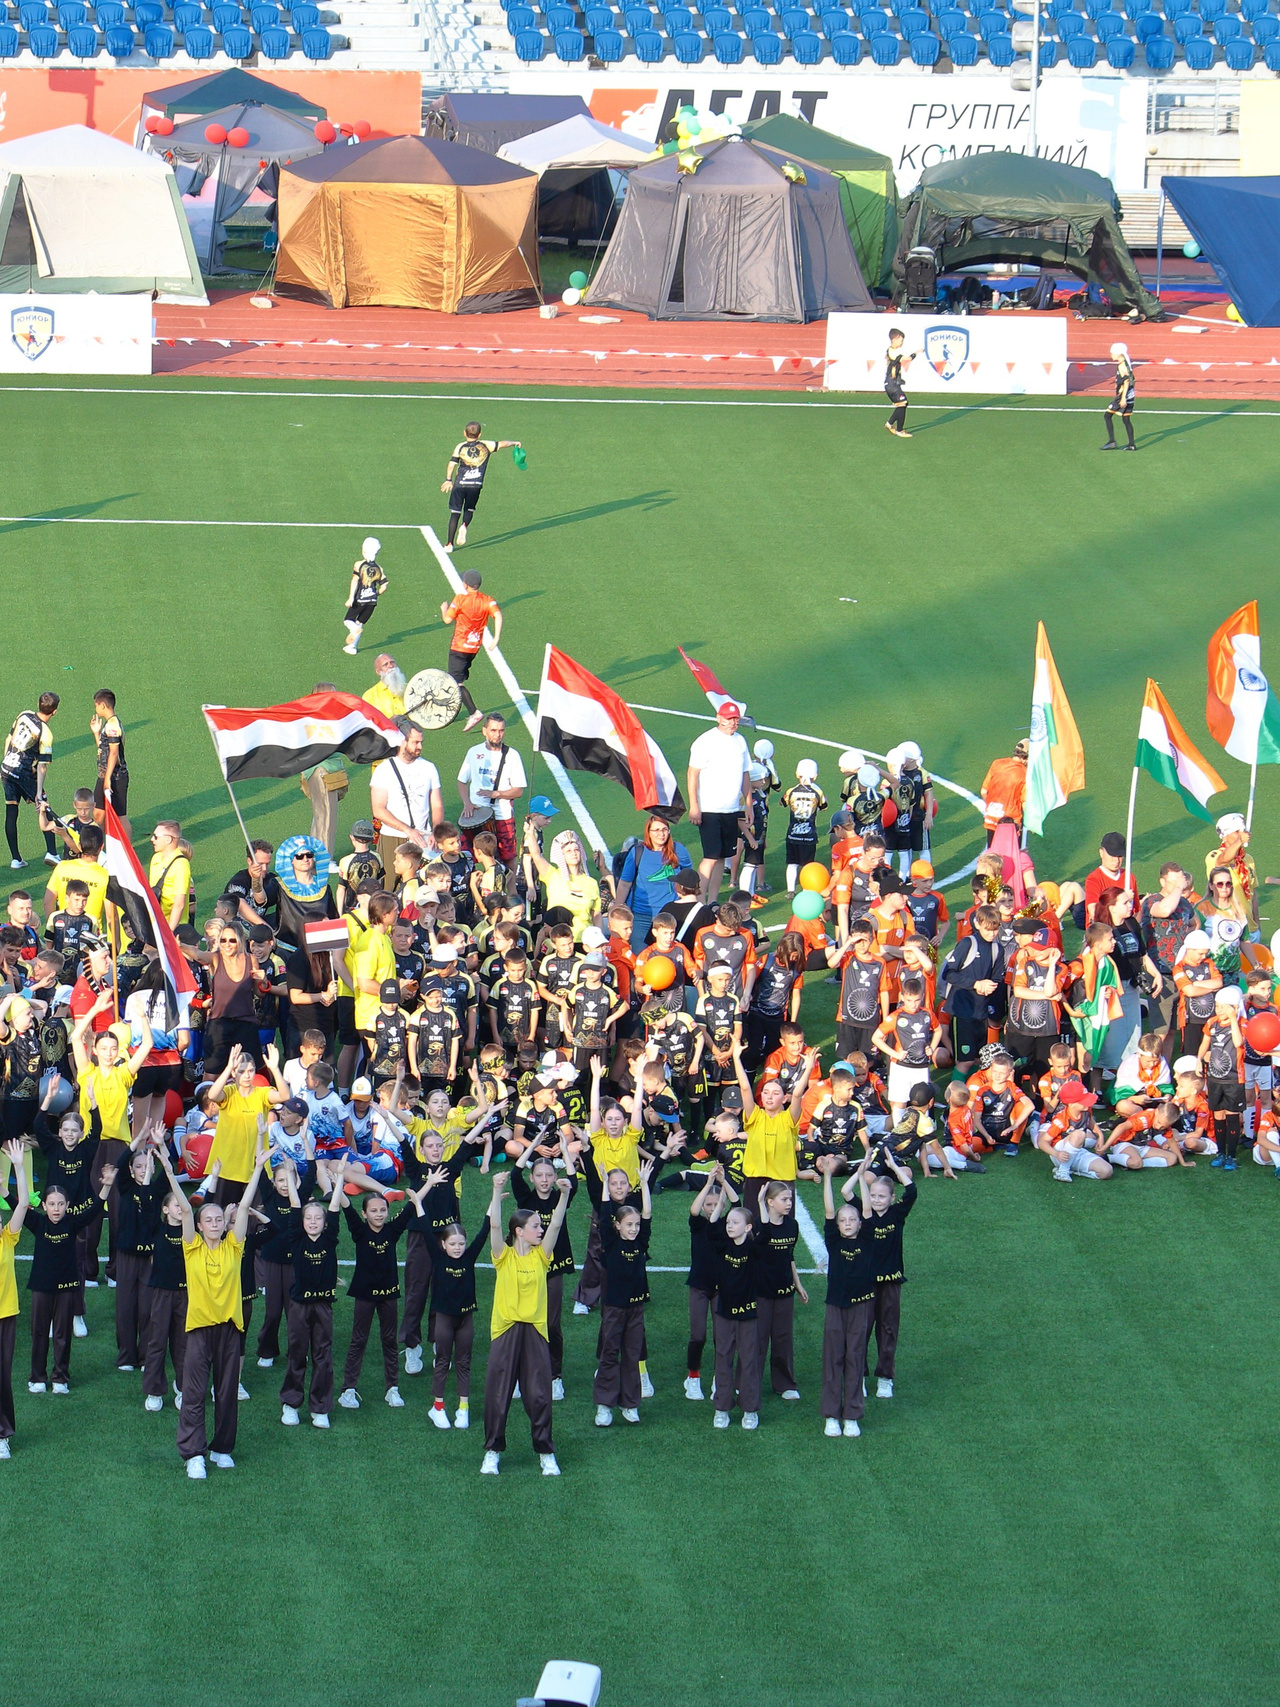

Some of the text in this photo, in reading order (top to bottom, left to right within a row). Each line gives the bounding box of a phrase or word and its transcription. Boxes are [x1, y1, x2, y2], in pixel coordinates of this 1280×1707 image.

[907, 103, 1032, 130] ГРУППА
[794, 800, 812, 819] 25
[694, 1083, 704, 1094] 10
[304, 1288, 337, 1298] DANCE
[851, 1292, 875, 1303] DANCE
